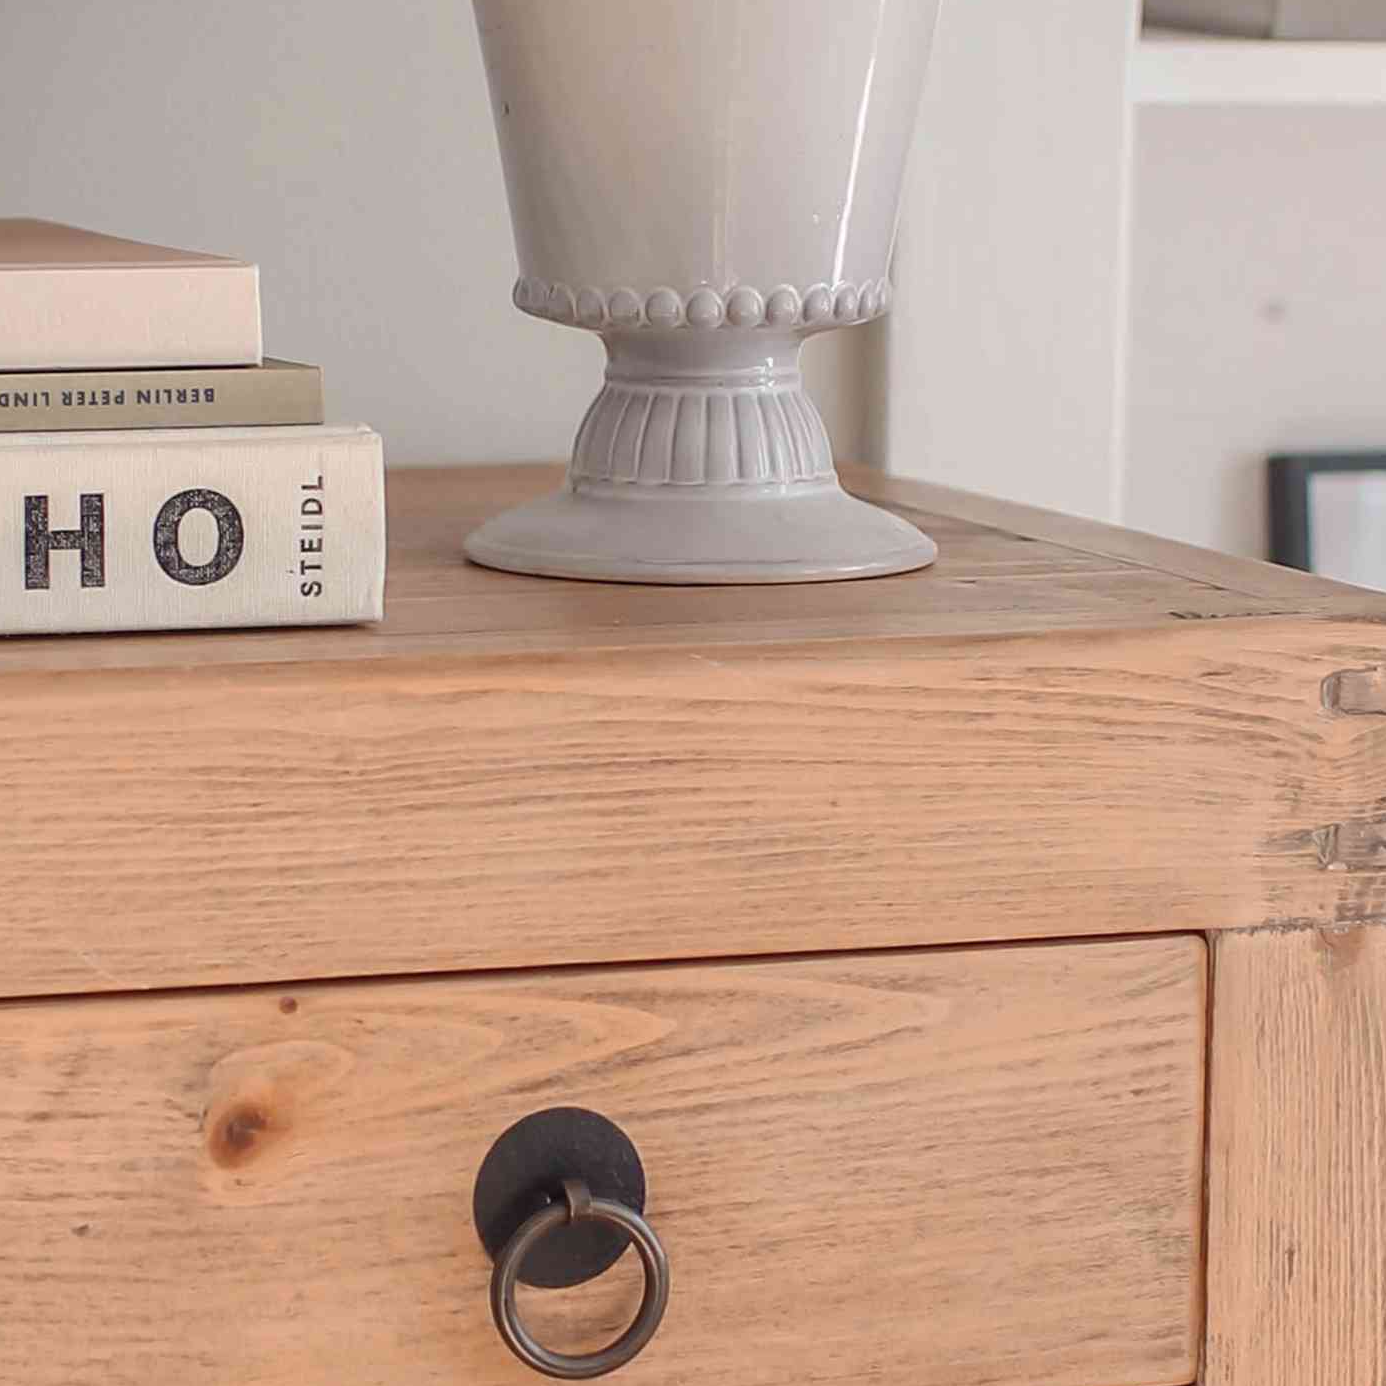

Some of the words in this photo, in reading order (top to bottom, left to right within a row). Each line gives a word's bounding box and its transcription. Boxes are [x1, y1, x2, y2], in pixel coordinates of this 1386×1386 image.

[61, 390, 125, 407] PETER
[136, 388, 215, 404] BERLIN
[300, 474, 325, 597] STEIDL
